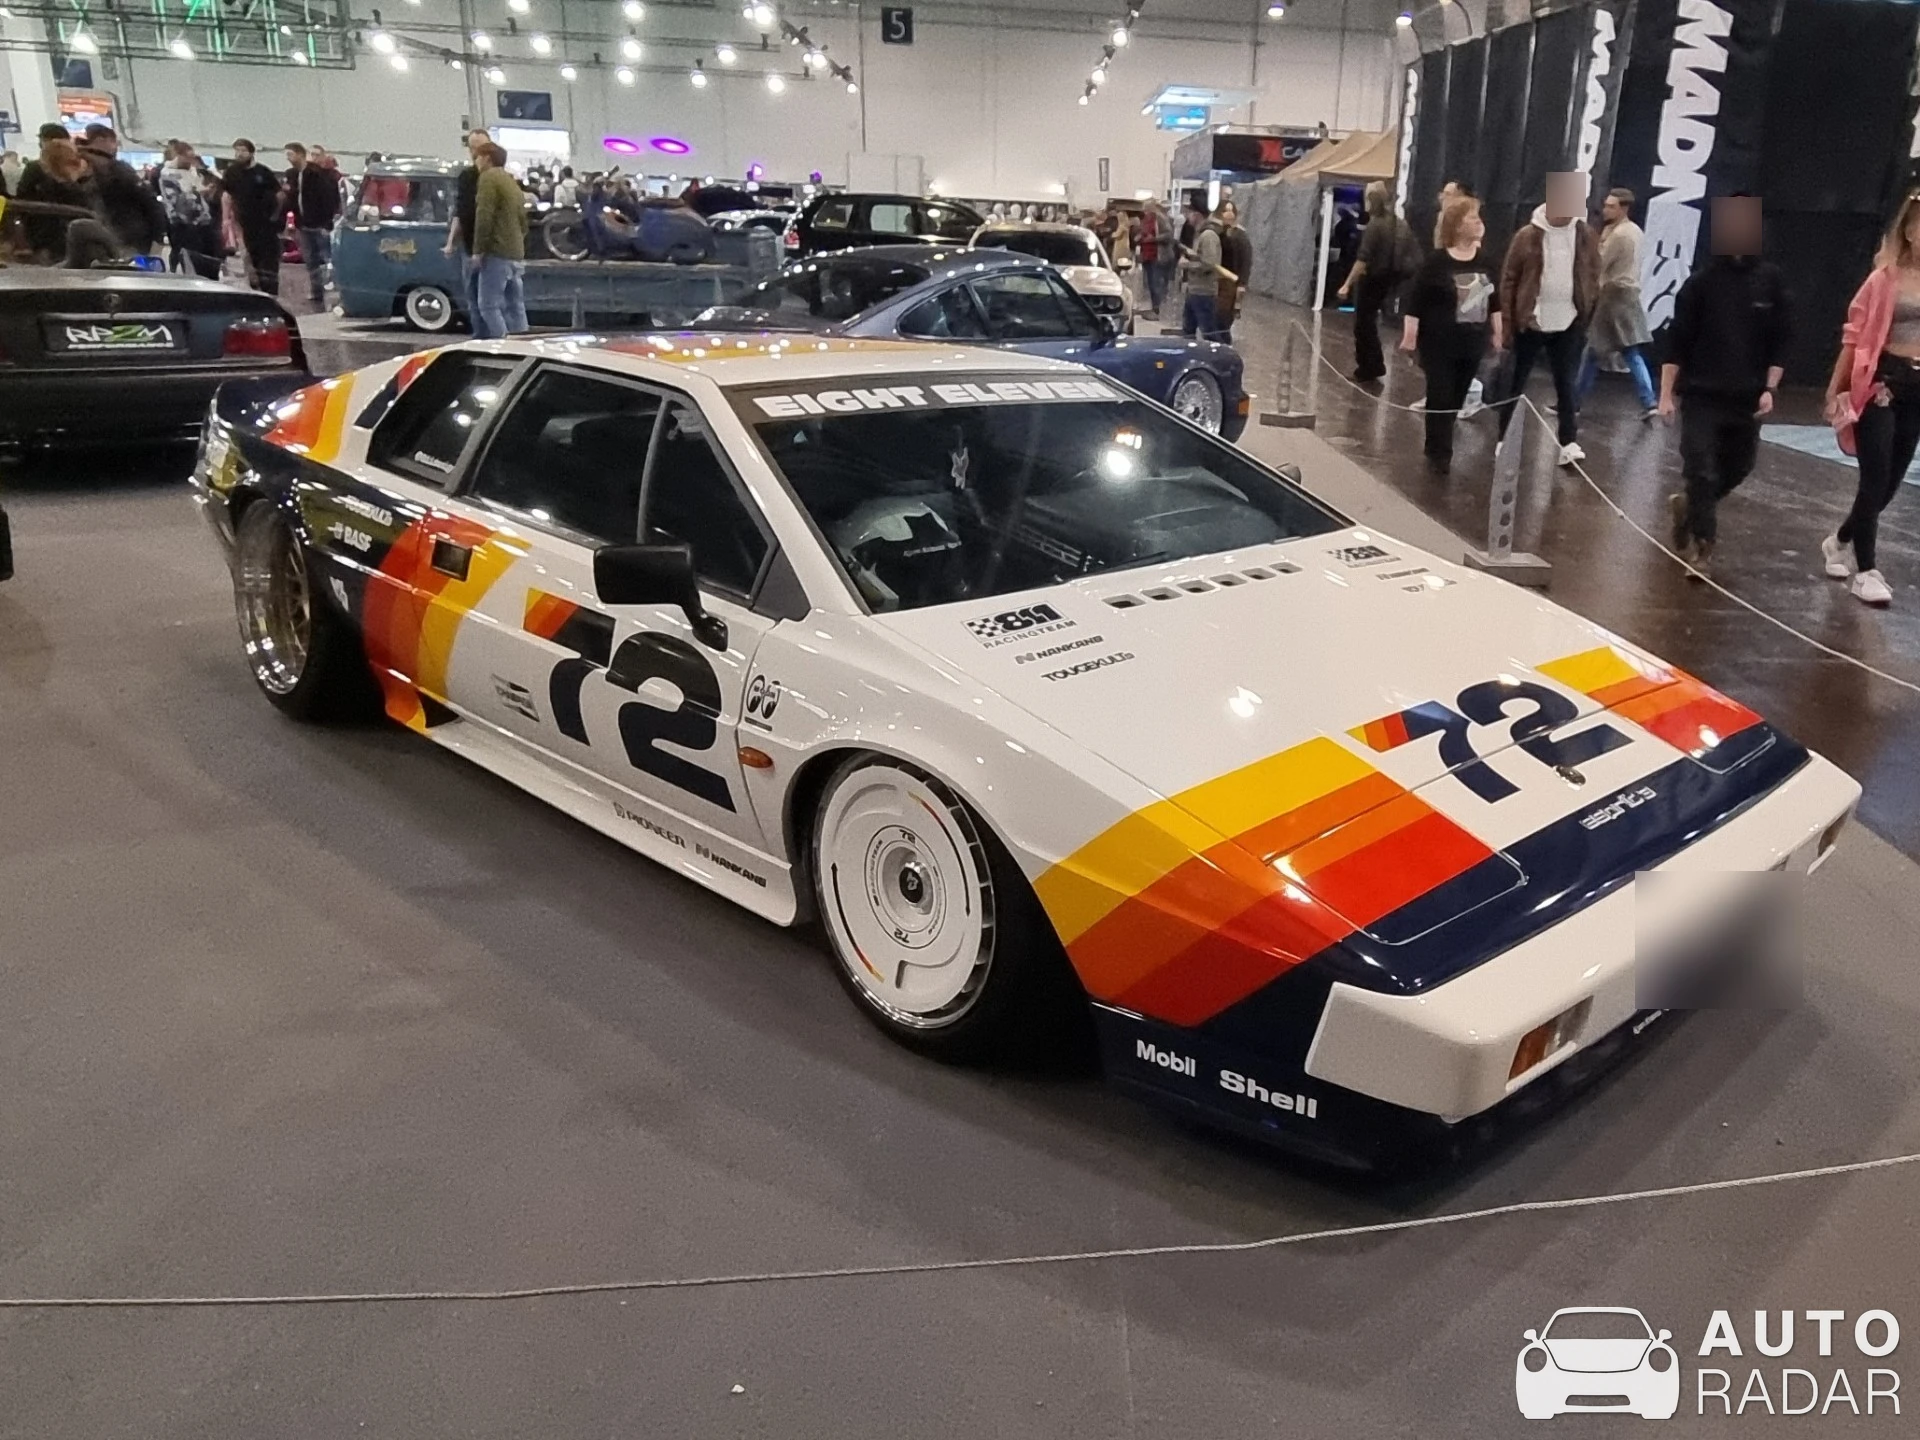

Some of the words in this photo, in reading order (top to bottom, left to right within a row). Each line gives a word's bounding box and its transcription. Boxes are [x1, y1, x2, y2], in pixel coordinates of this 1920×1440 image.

[890, 10, 906, 39] 5
[753, 386, 930, 417] EIGHT
[931, 382, 1118, 404] ELEVEN
[993, 603, 1063, 631] 811
[1344, 680, 1635, 804] 72
[626, 810, 686, 849] PIONEER
[1136, 1039, 1196, 1077] Mobil
[1219, 1069, 1318, 1119] Shell
